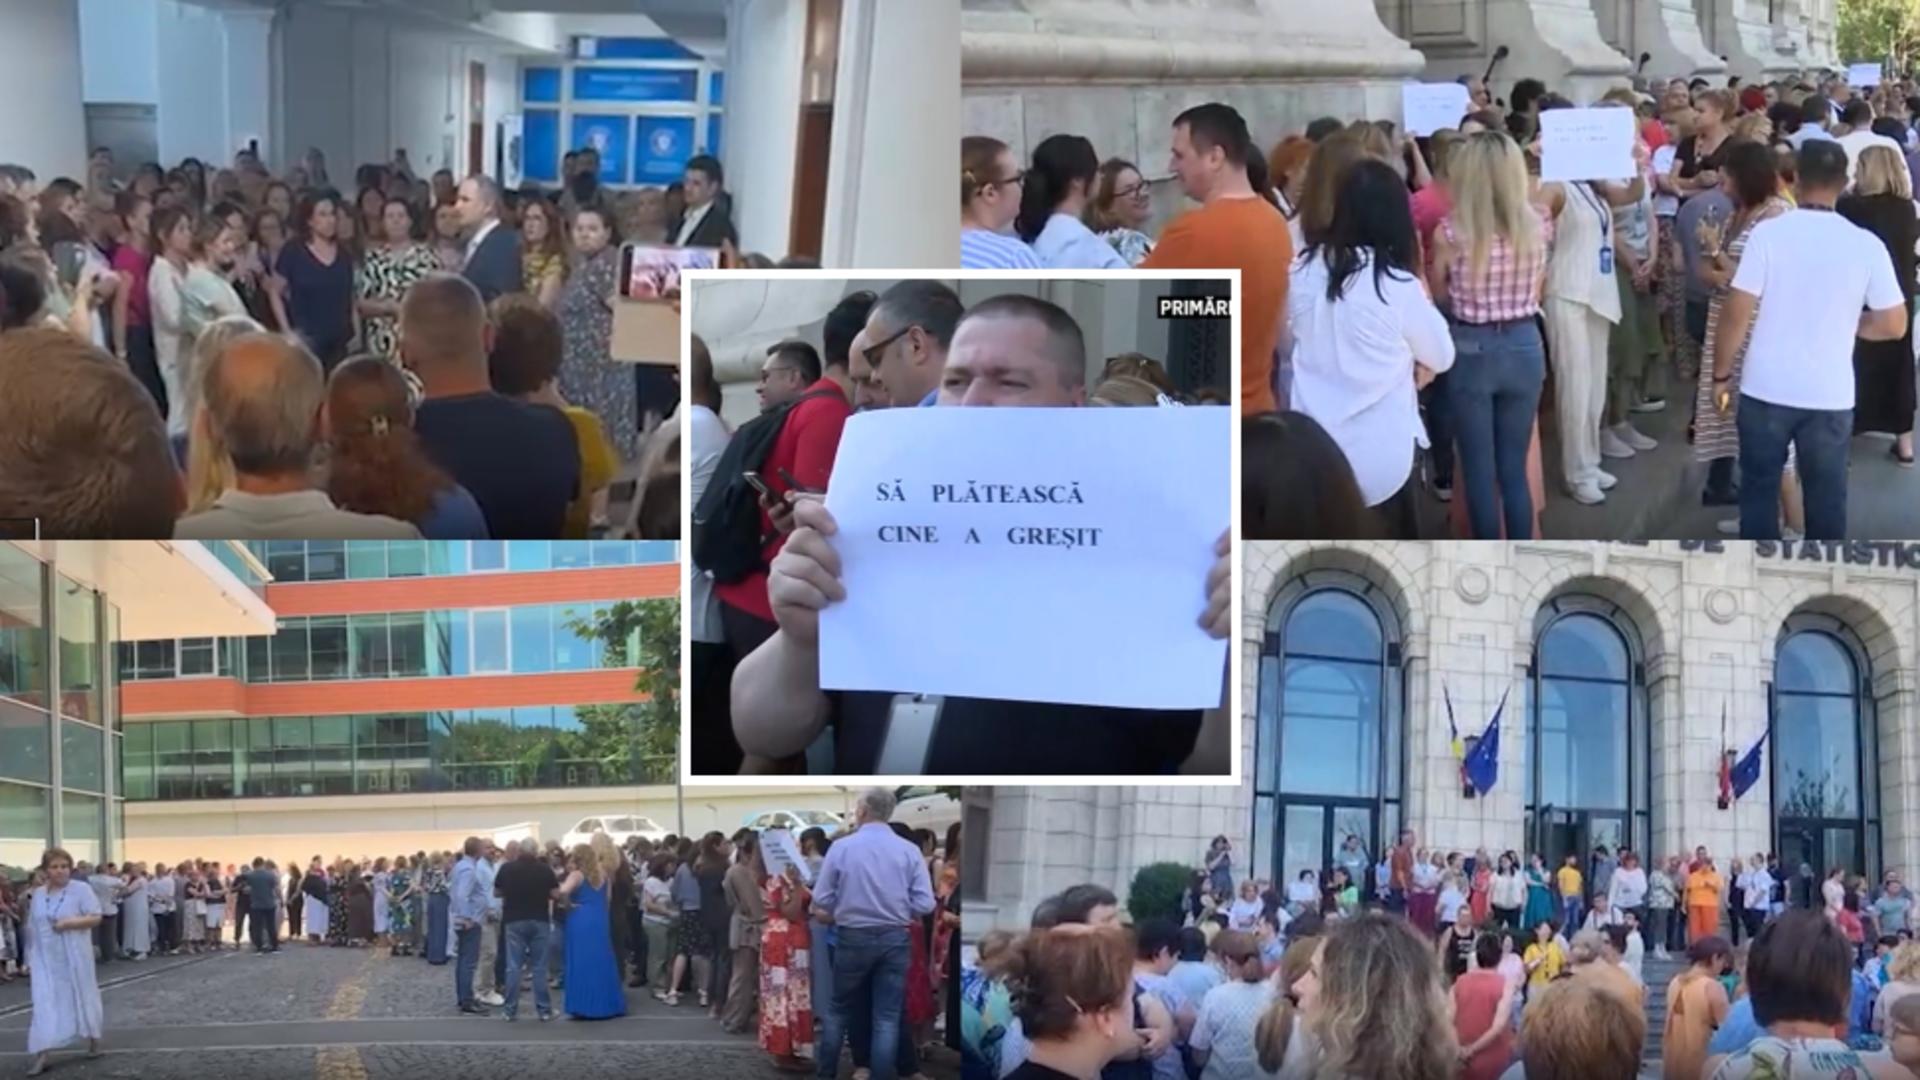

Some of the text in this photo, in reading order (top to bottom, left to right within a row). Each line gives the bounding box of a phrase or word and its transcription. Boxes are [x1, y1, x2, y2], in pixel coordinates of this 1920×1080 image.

[876, 478, 1085, 504] SĂ PLĂTEASCĂ
[877, 525, 1102, 549] CINE A GREȘIT
